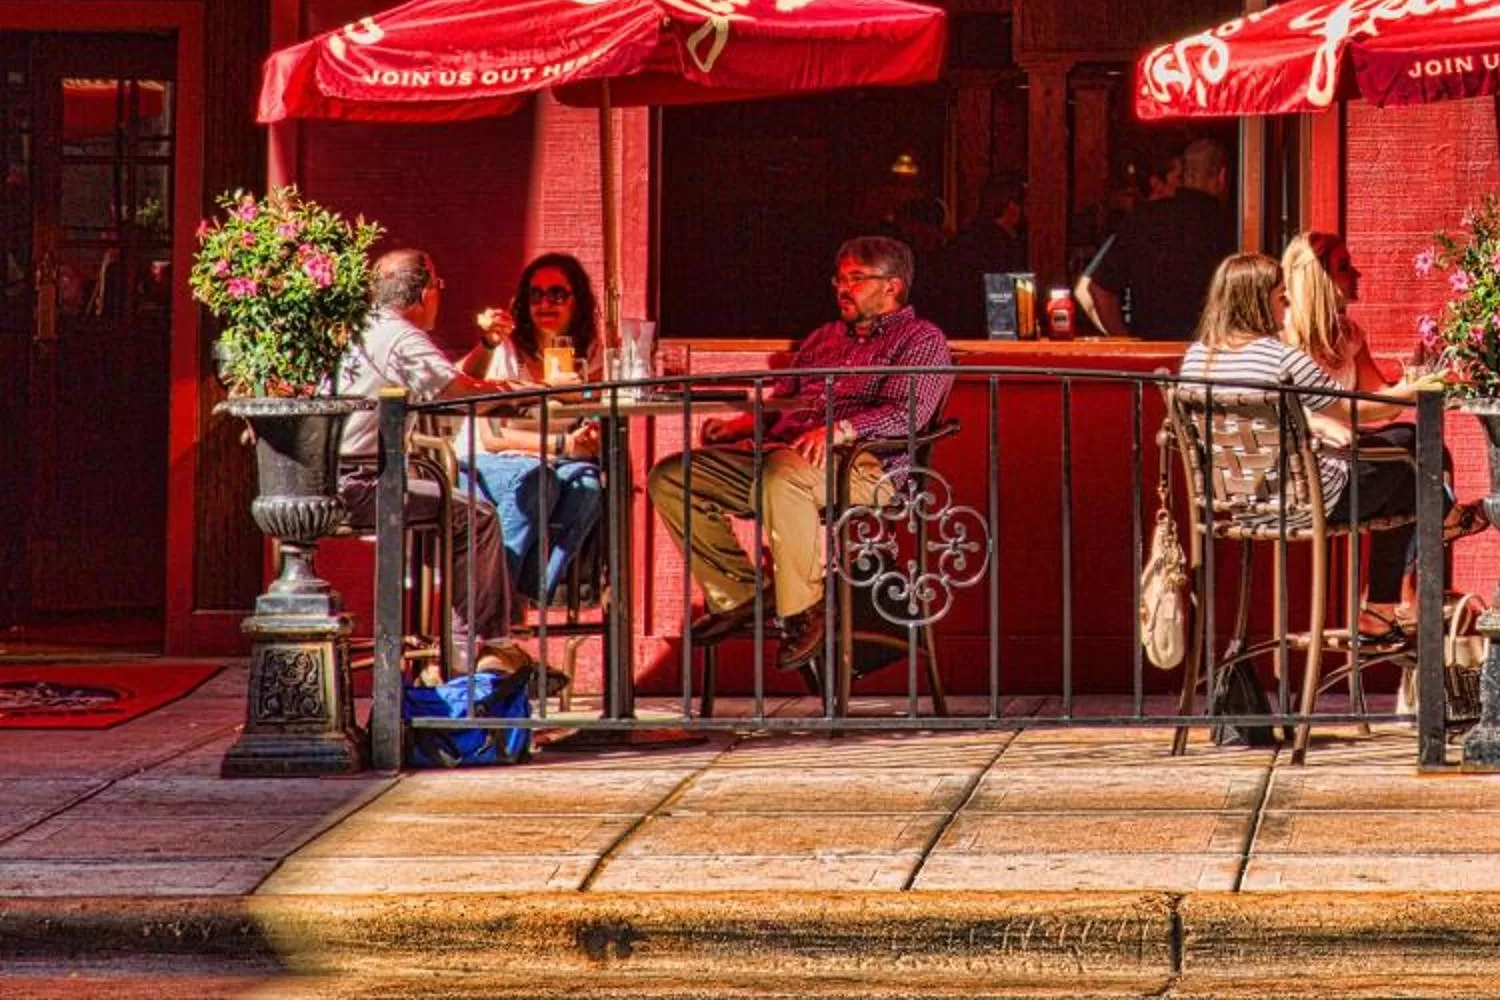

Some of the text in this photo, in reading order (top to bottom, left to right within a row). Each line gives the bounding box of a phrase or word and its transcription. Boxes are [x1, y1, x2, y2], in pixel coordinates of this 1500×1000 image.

[364, 68, 431, 86] JOIN
[438, 70, 474, 87] US
[480, 67, 535, 85] OUT
[1408, 56, 1474, 78] JOIN
